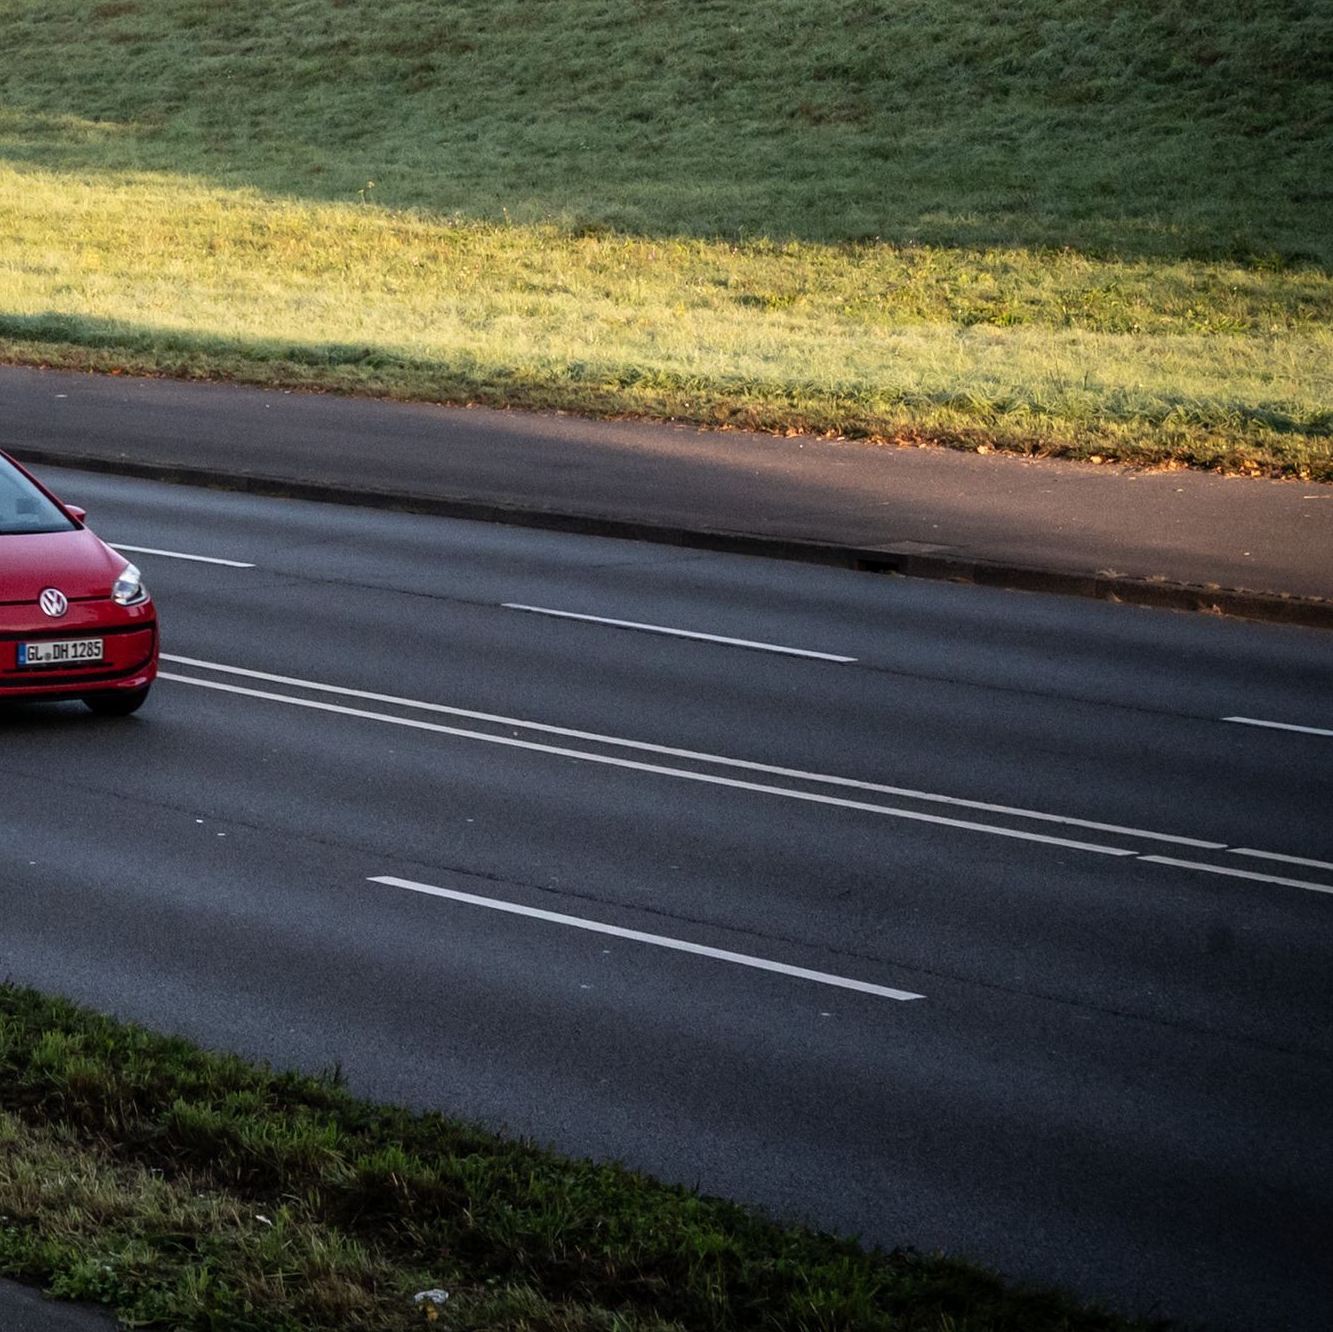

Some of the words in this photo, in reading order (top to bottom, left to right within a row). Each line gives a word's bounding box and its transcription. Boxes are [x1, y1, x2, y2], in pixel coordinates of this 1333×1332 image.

[27, 645, 43, 661] GL
[53, 644, 69, 660] DH
[71, 641, 102, 659] 1285
